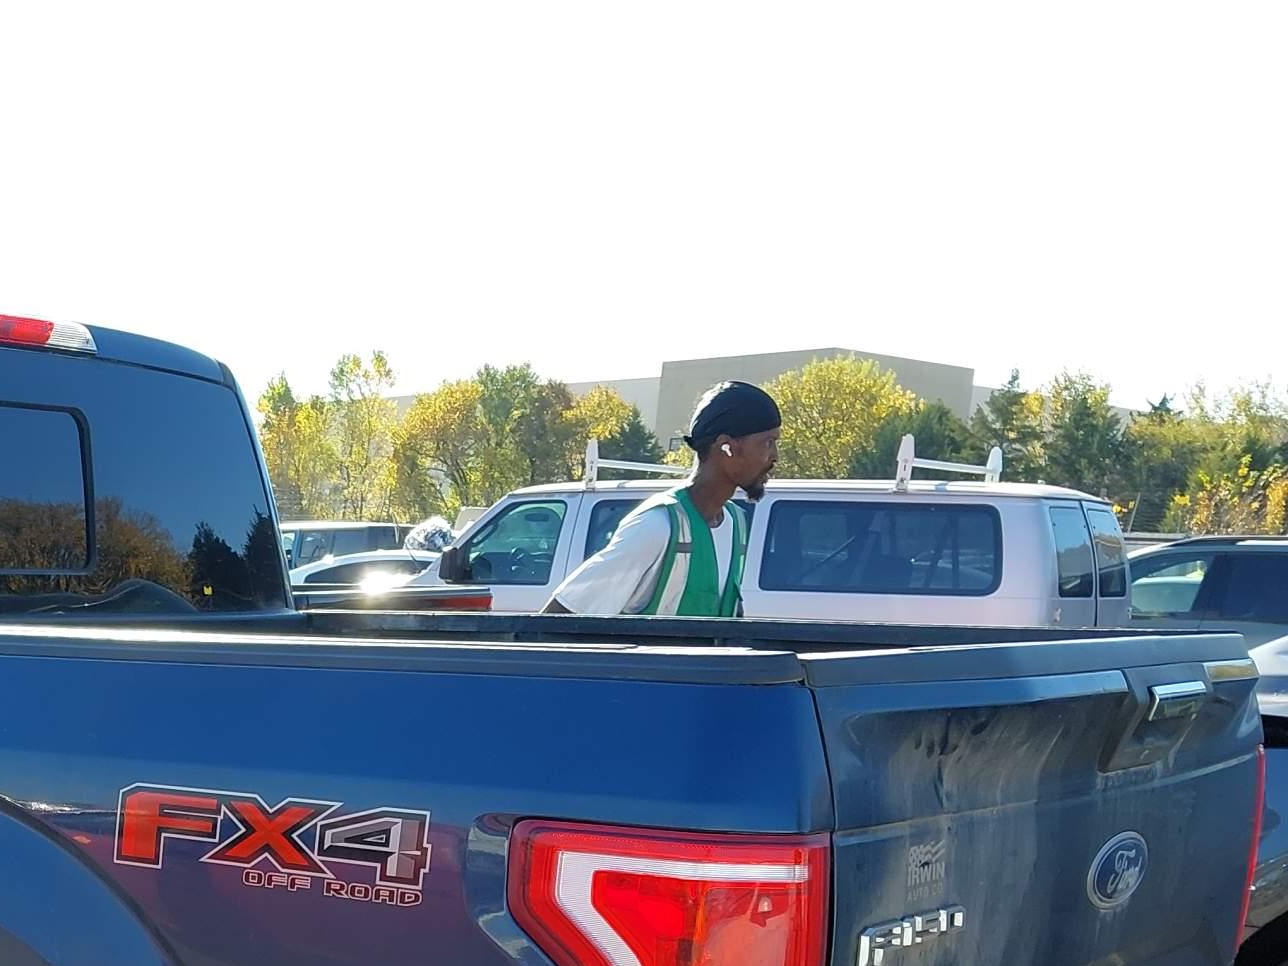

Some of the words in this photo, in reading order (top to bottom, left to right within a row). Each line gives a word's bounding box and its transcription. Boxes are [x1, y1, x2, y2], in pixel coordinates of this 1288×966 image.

[114, 782, 432, 890] FX4
[243, 869, 312, 892] OFF
[323, 878, 423, 907] ROAD
[907, 861, 945, 887] IRWIN
